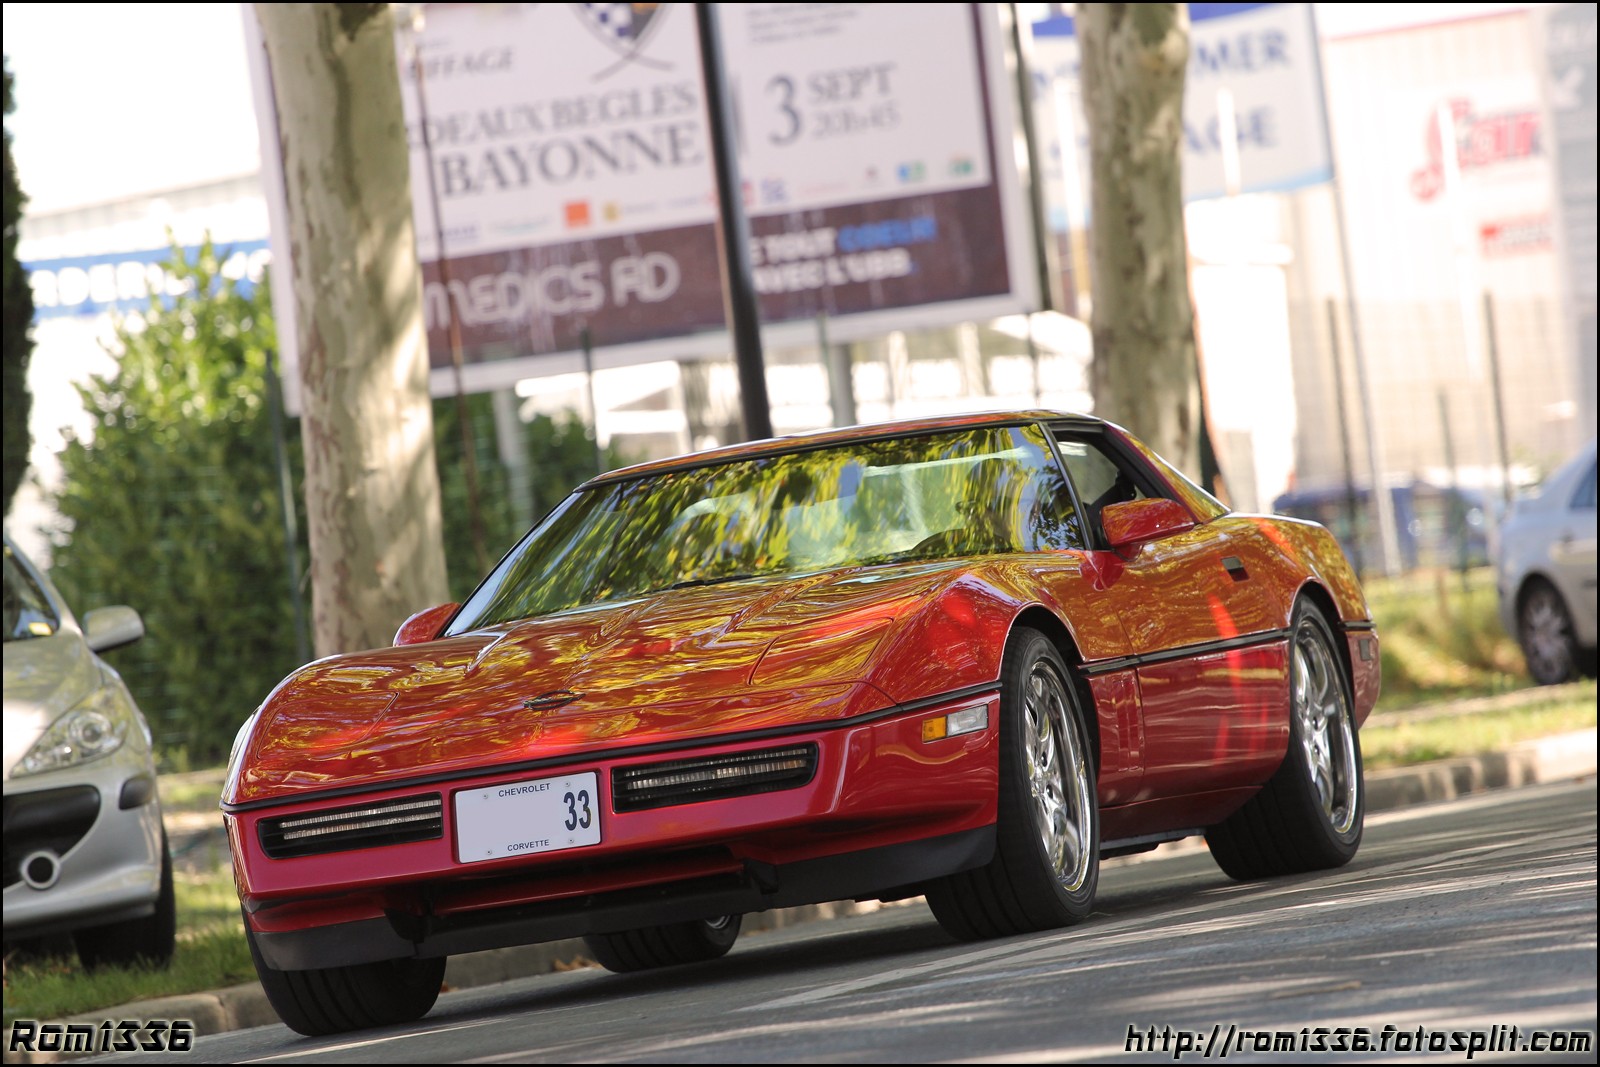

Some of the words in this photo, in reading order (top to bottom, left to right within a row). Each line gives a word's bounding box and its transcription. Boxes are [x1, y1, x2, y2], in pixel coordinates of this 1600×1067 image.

[411, 100, 548, 148] DEAUX
[551, 81, 699, 136] BEGLES
[766, 74, 802, 146] 3
[808, 62, 897, 106] SEPT
[439, 122, 705, 198] BAYONNE
[498, 782, 551, 798] CHEVROLET
[563, 789, 592, 831] 33
[507, 838, 550, 852] CORVETTE
